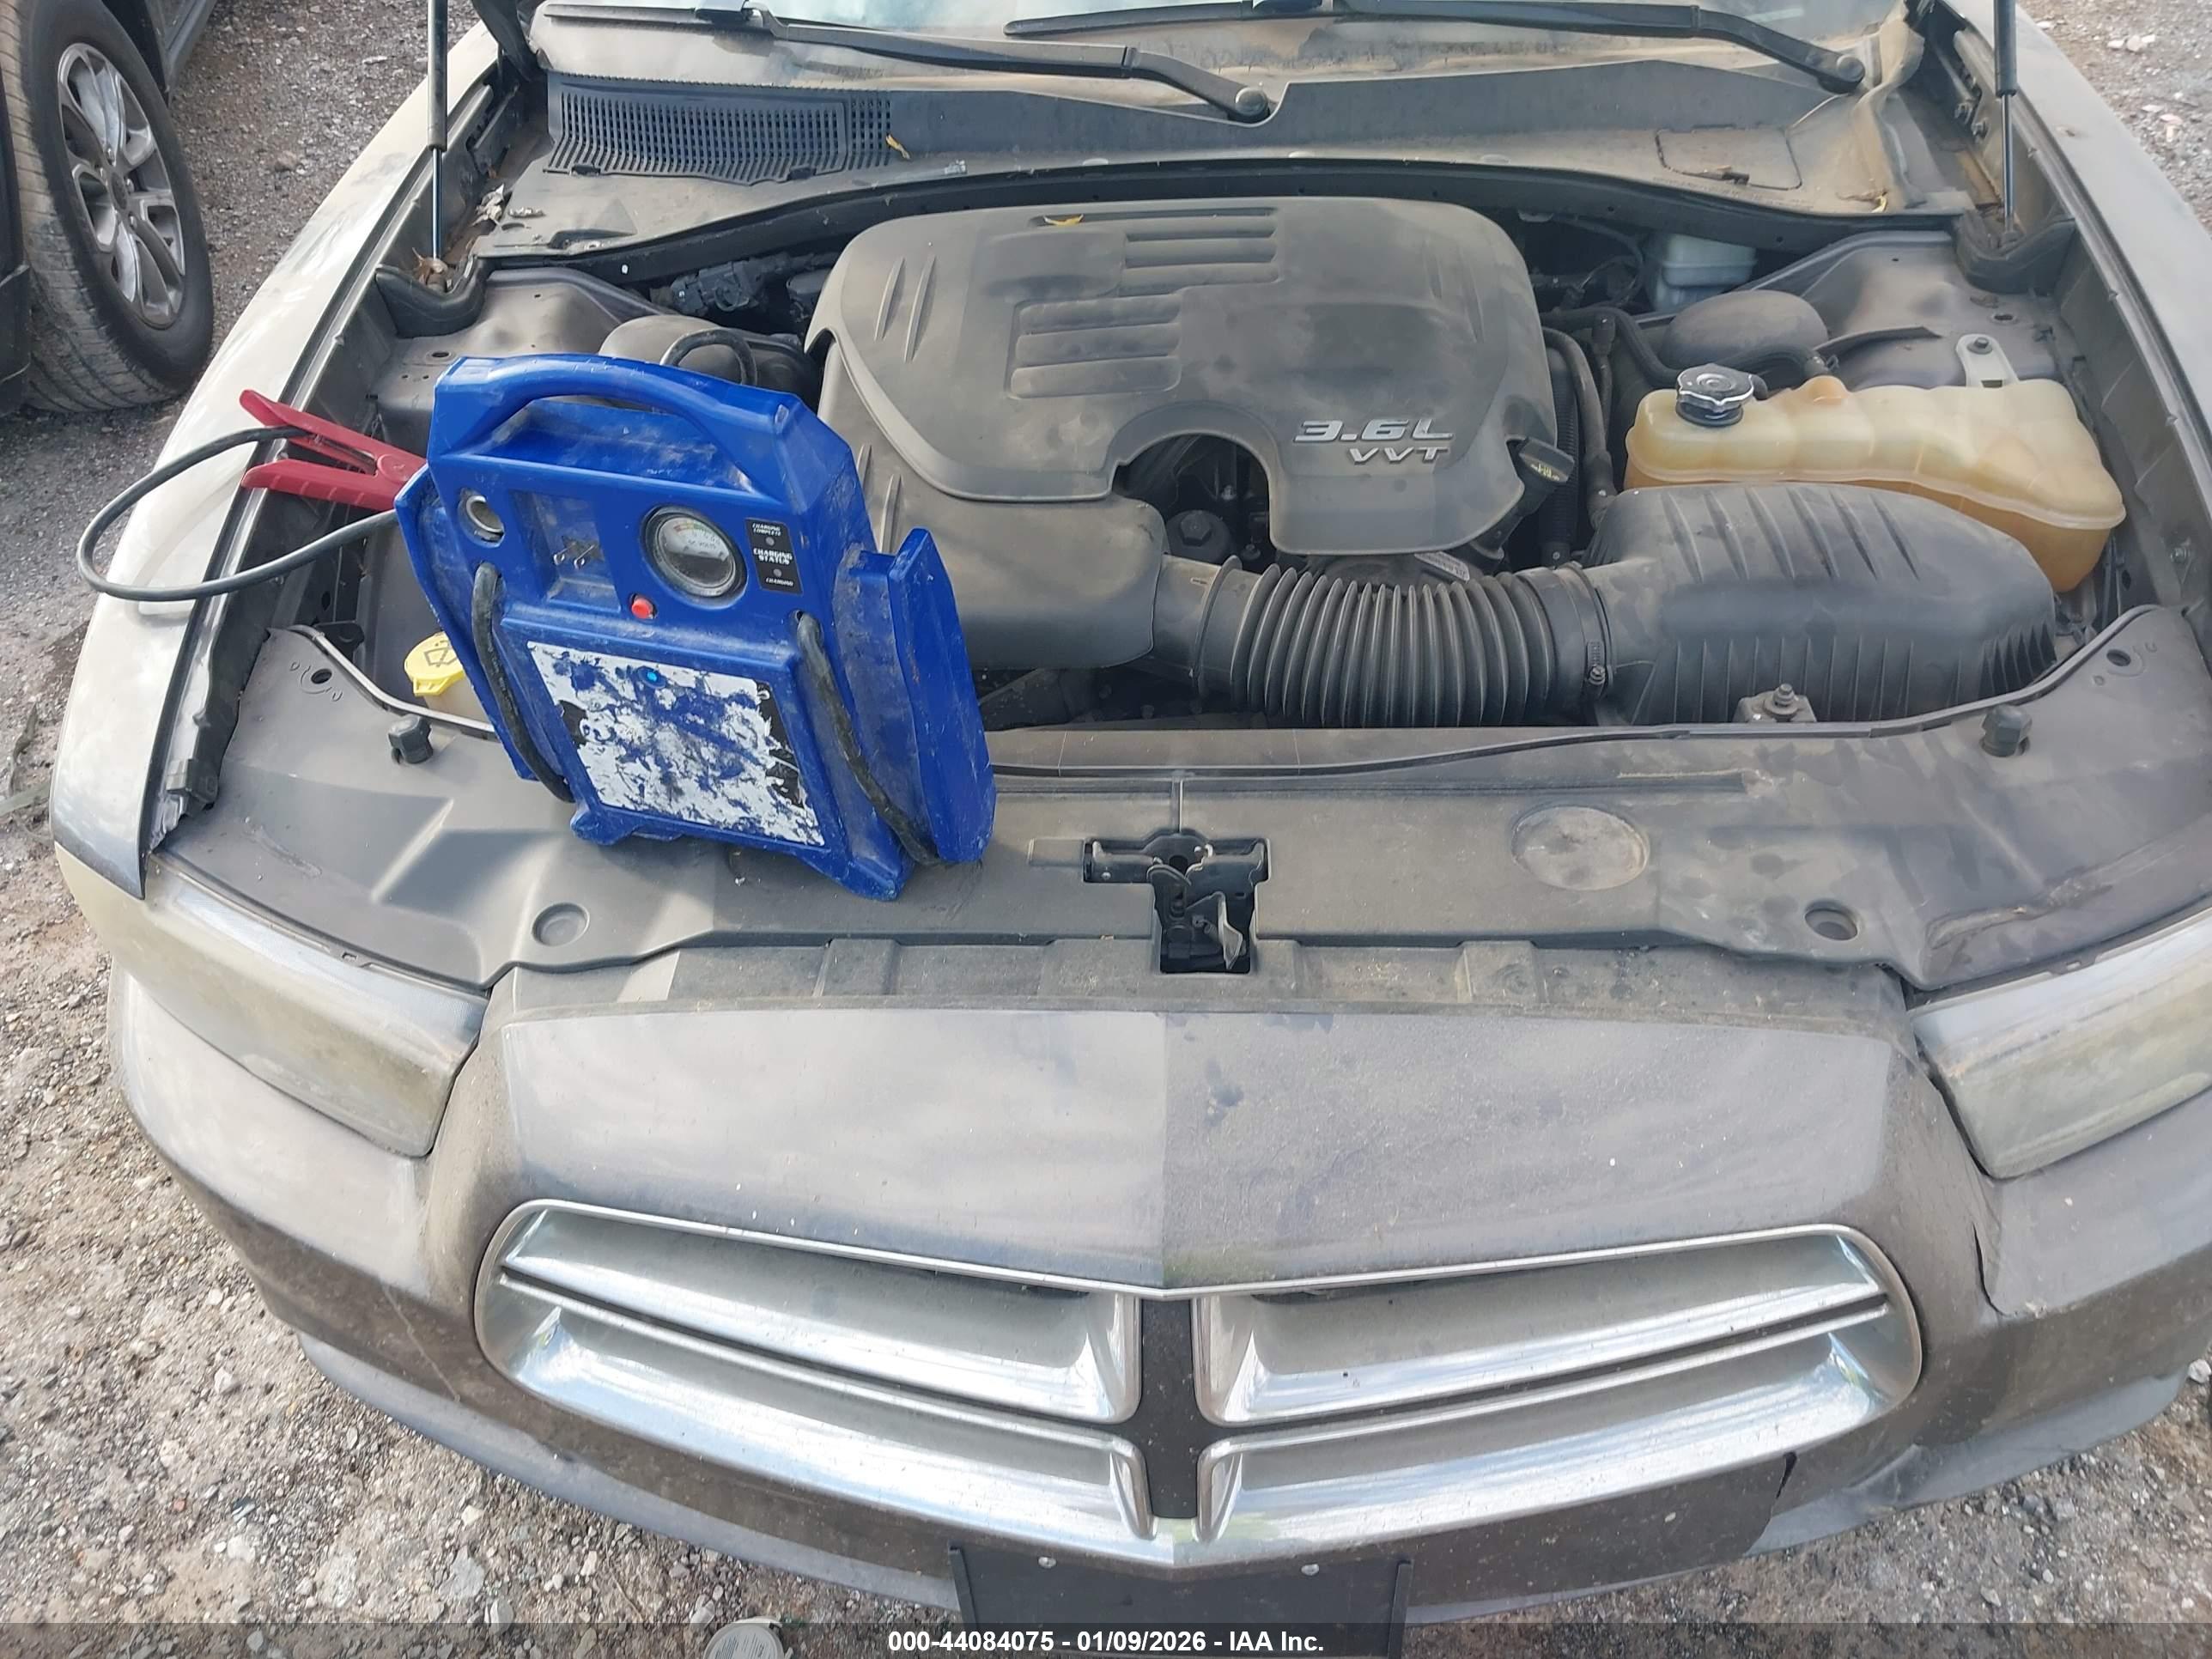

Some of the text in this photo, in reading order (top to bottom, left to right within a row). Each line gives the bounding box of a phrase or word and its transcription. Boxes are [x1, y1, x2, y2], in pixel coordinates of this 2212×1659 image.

[1294, 418, 1453, 443] 3.6L
[1348, 447, 1449, 465] VVT
[753, 548, 793, 561] CHARGING
[758, 555, 790, 565] STATUS
